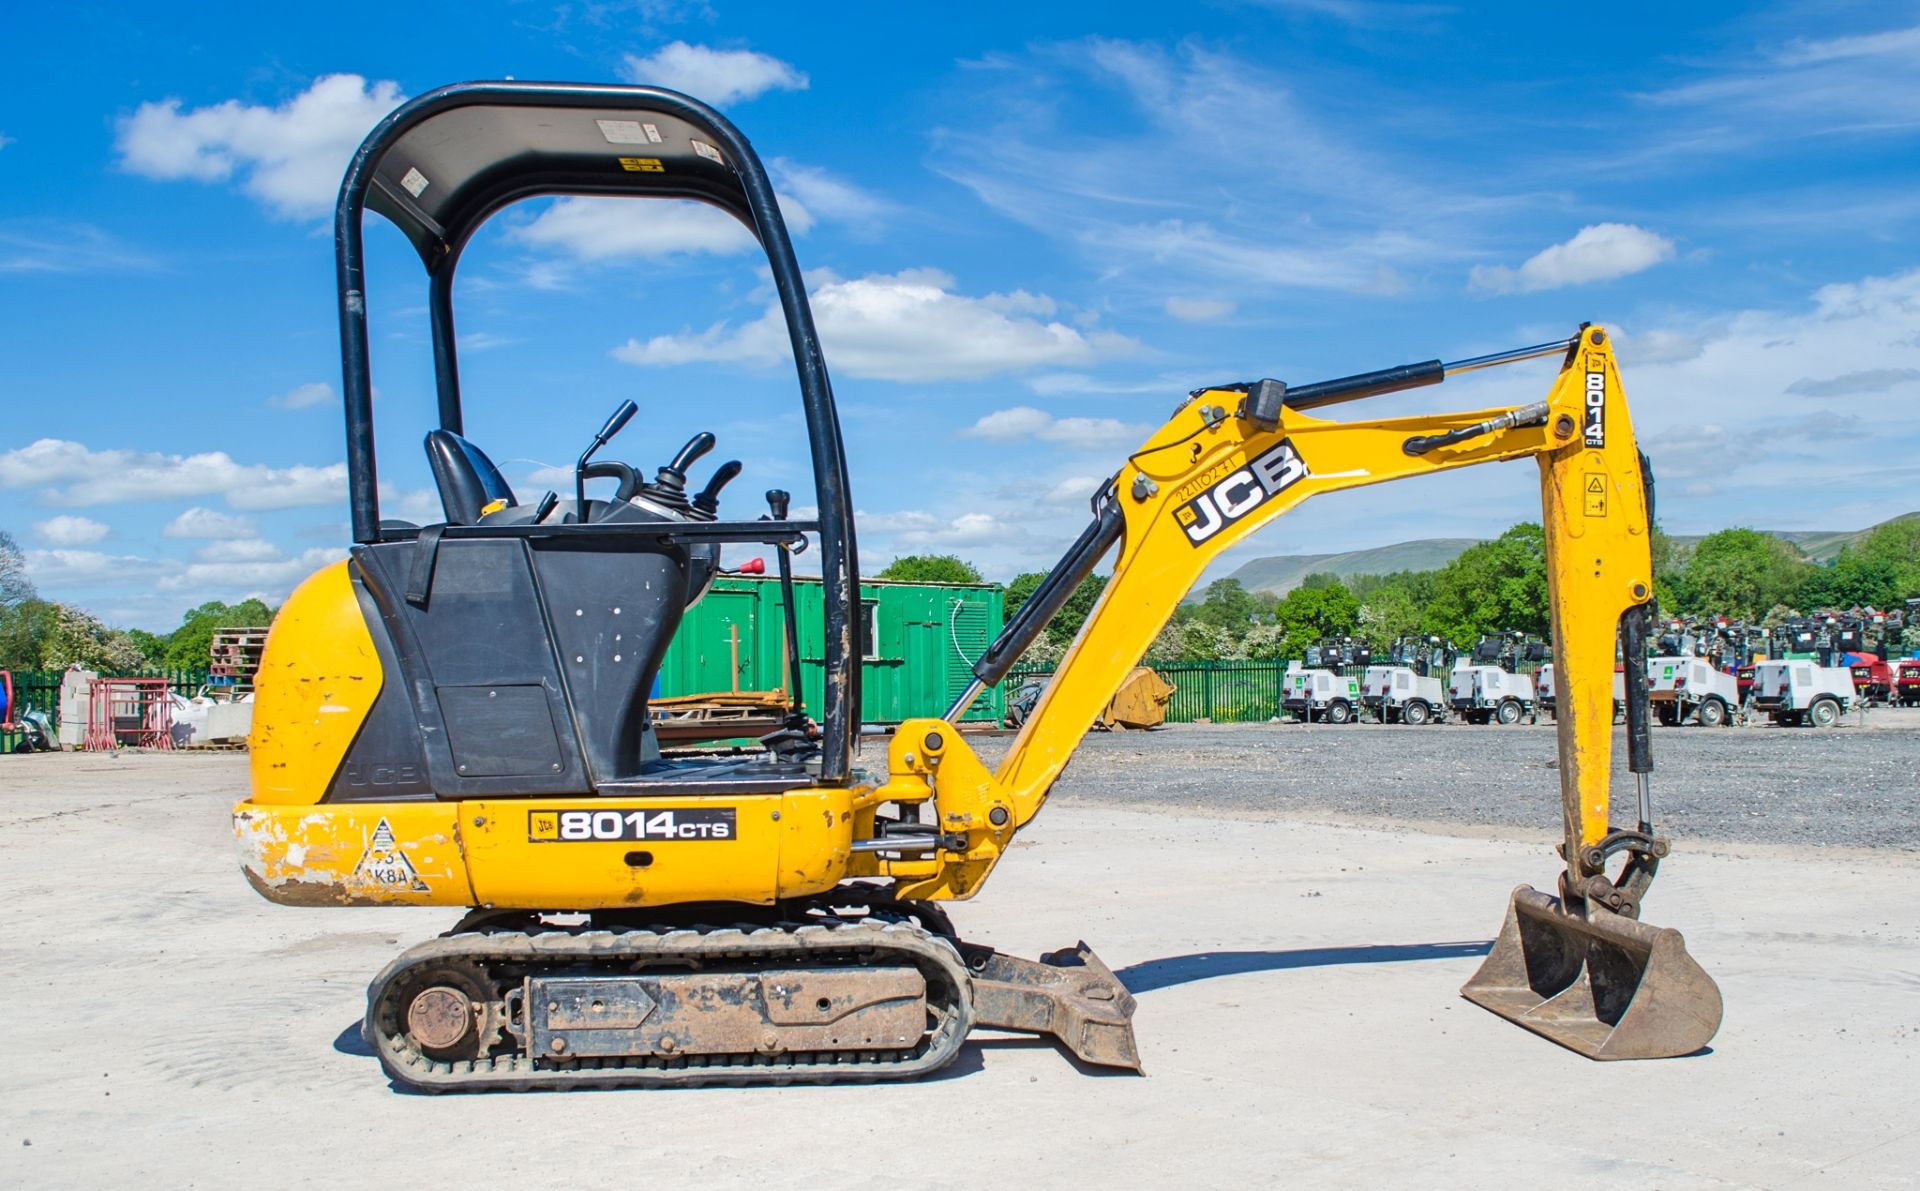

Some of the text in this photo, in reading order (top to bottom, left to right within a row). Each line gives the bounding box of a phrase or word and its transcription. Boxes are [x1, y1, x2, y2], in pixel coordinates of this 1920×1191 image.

[1585, 373, 1604, 439] 8014
[1186, 444, 1304, 541] JCB
[348, 762, 421, 786] JCB
